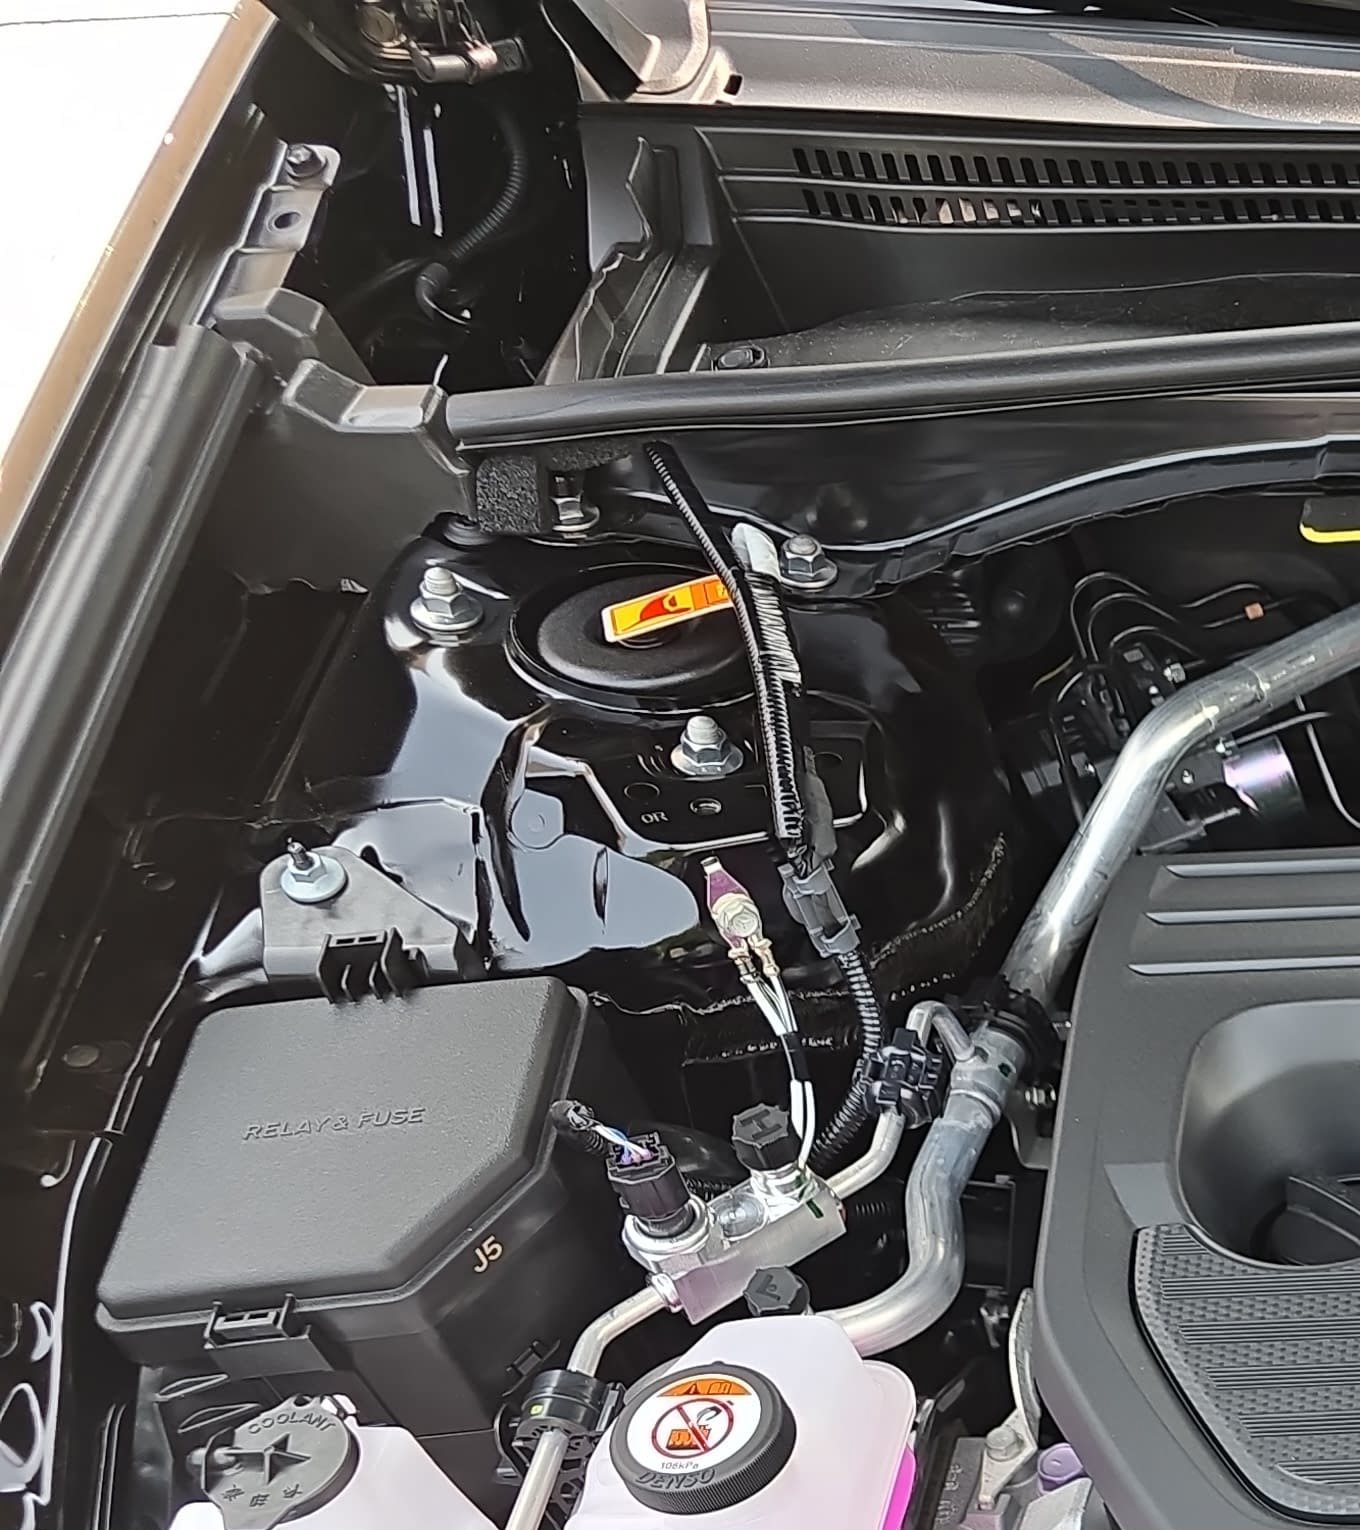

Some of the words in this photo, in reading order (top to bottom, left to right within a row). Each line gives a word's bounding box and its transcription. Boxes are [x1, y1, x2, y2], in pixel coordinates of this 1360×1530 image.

[356, 1106, 427, 1129] FUSE
[471, 1234, 505, 1274] J5
[247, 1411, 337, 1435] COOLANT
[635, 1469, 717, 1490] DENSO
